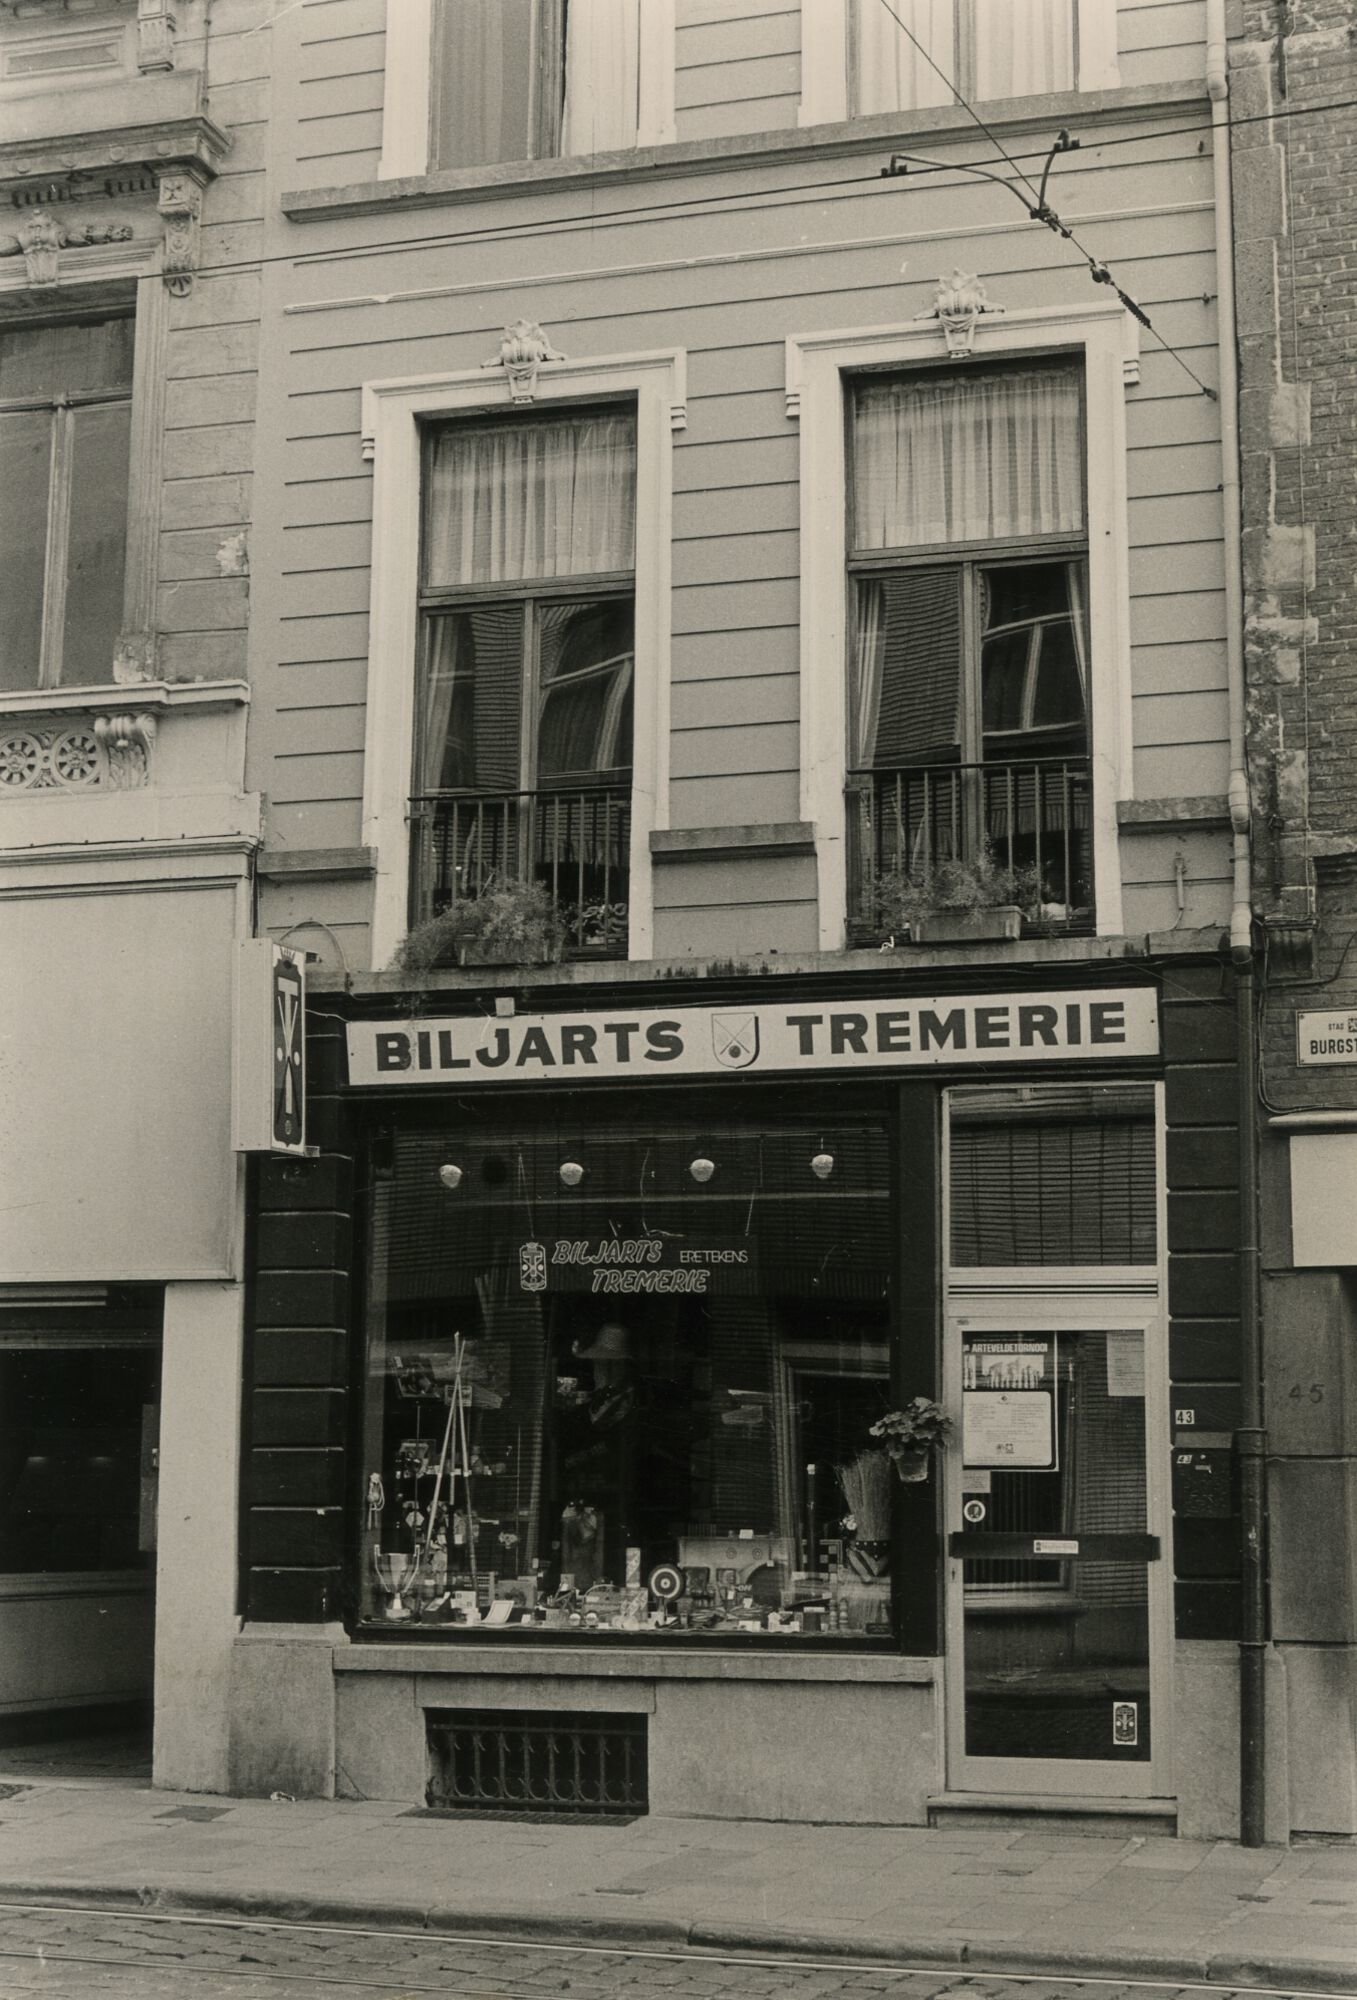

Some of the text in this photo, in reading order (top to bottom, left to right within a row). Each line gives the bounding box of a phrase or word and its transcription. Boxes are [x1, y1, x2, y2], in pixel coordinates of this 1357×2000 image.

[375, 1001, 1126, 1072] BILJARTS TREMERIE
[552, 1240, 663, 1265] BILJARTS
[680, 1250, 749, 1263] ERETEKENS
[591, 1269, 711, 1294] TREMERIE
[1288, 1383, 1325, 1404] 45
[1176, 1410, 1194, 1424] 43
